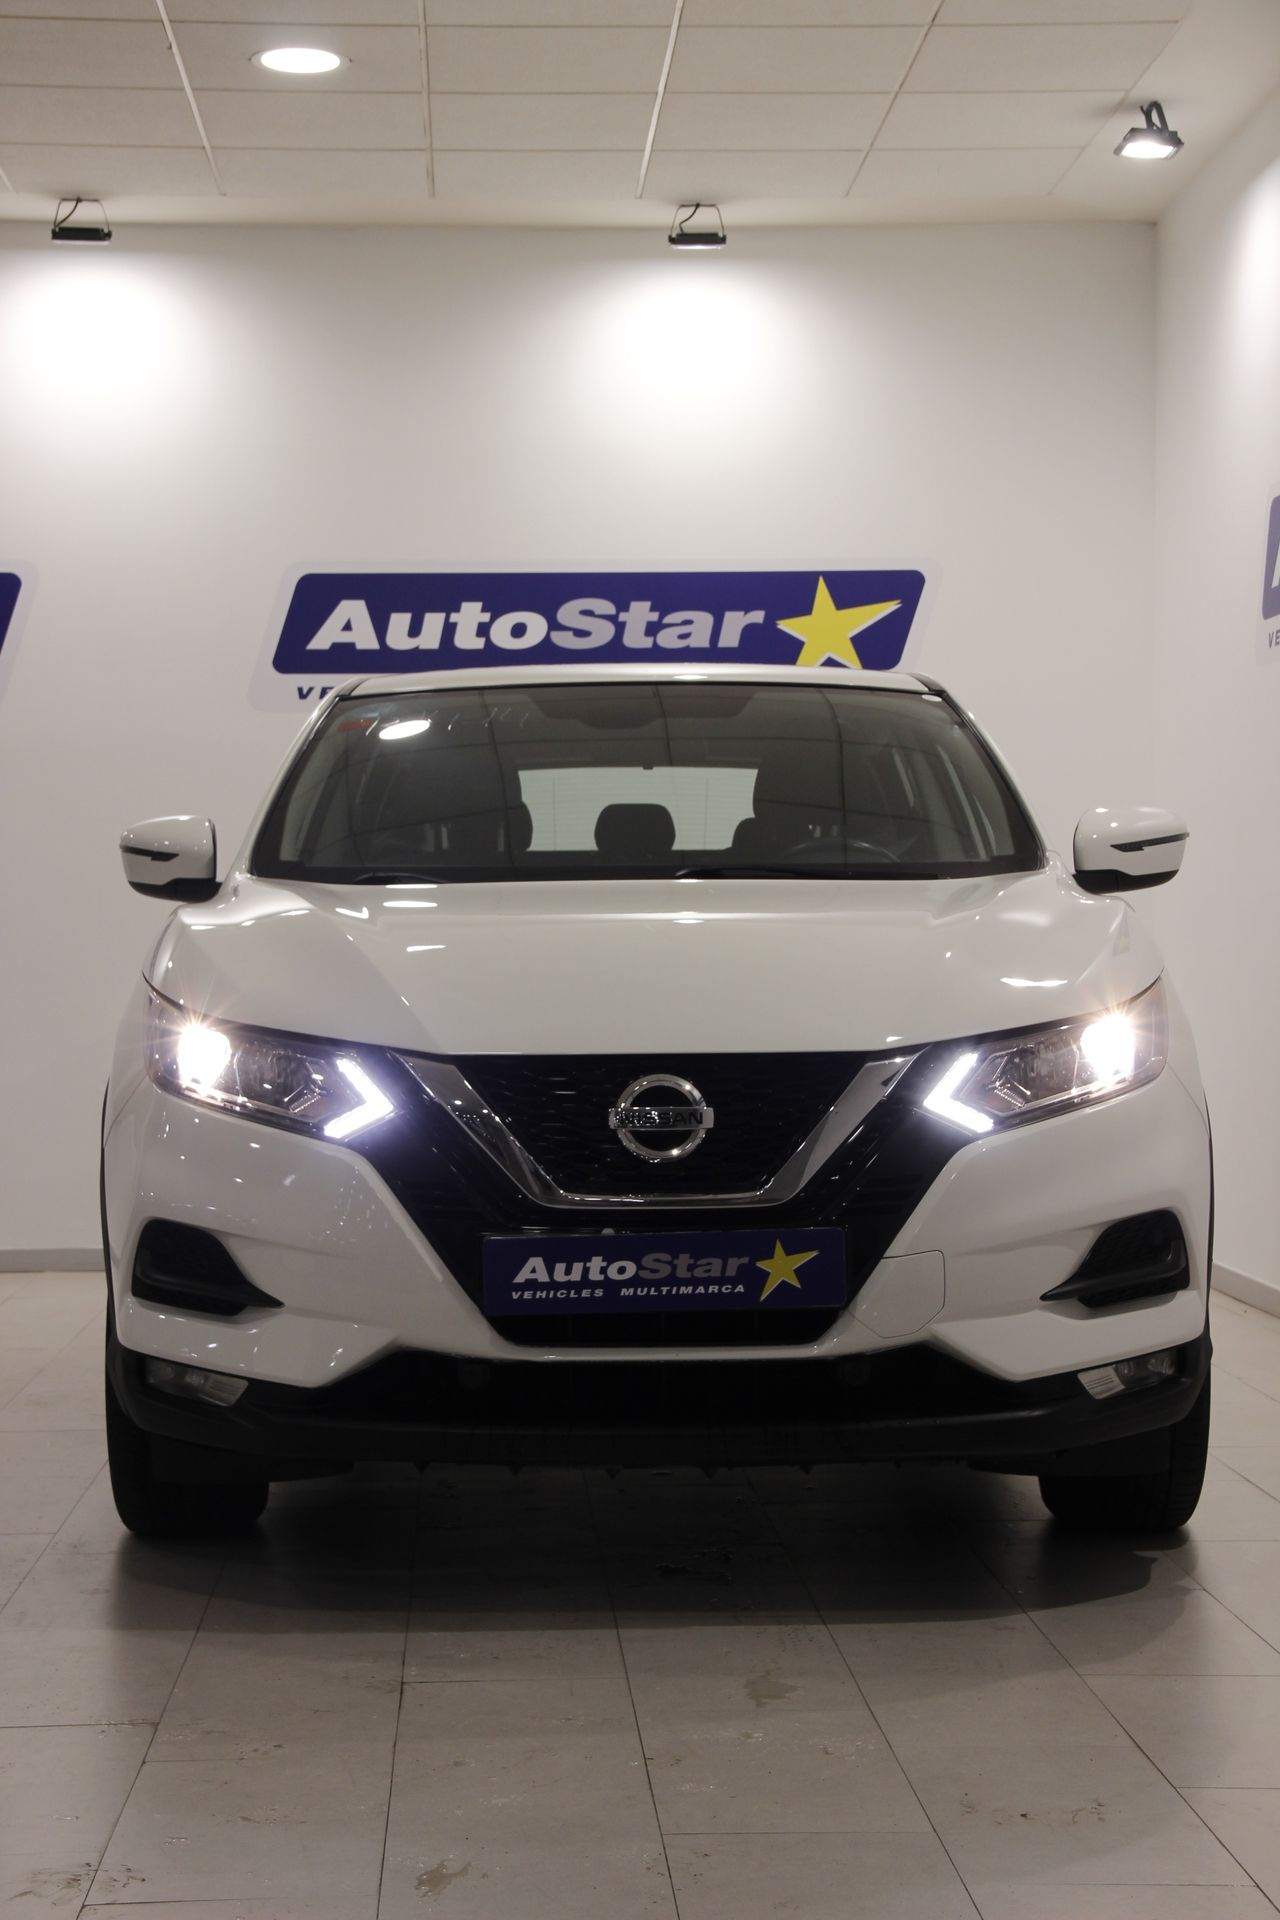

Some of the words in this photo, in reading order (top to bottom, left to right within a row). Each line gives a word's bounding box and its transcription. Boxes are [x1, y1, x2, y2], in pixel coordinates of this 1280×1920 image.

[306, 597, 766, 651] AutoStar
[512, 1252, 749, 1283] AutoStar
[511, 1288, 605, 1300] VEHICLES
[620, 1284, 746, 1296] MULTIMARCA
